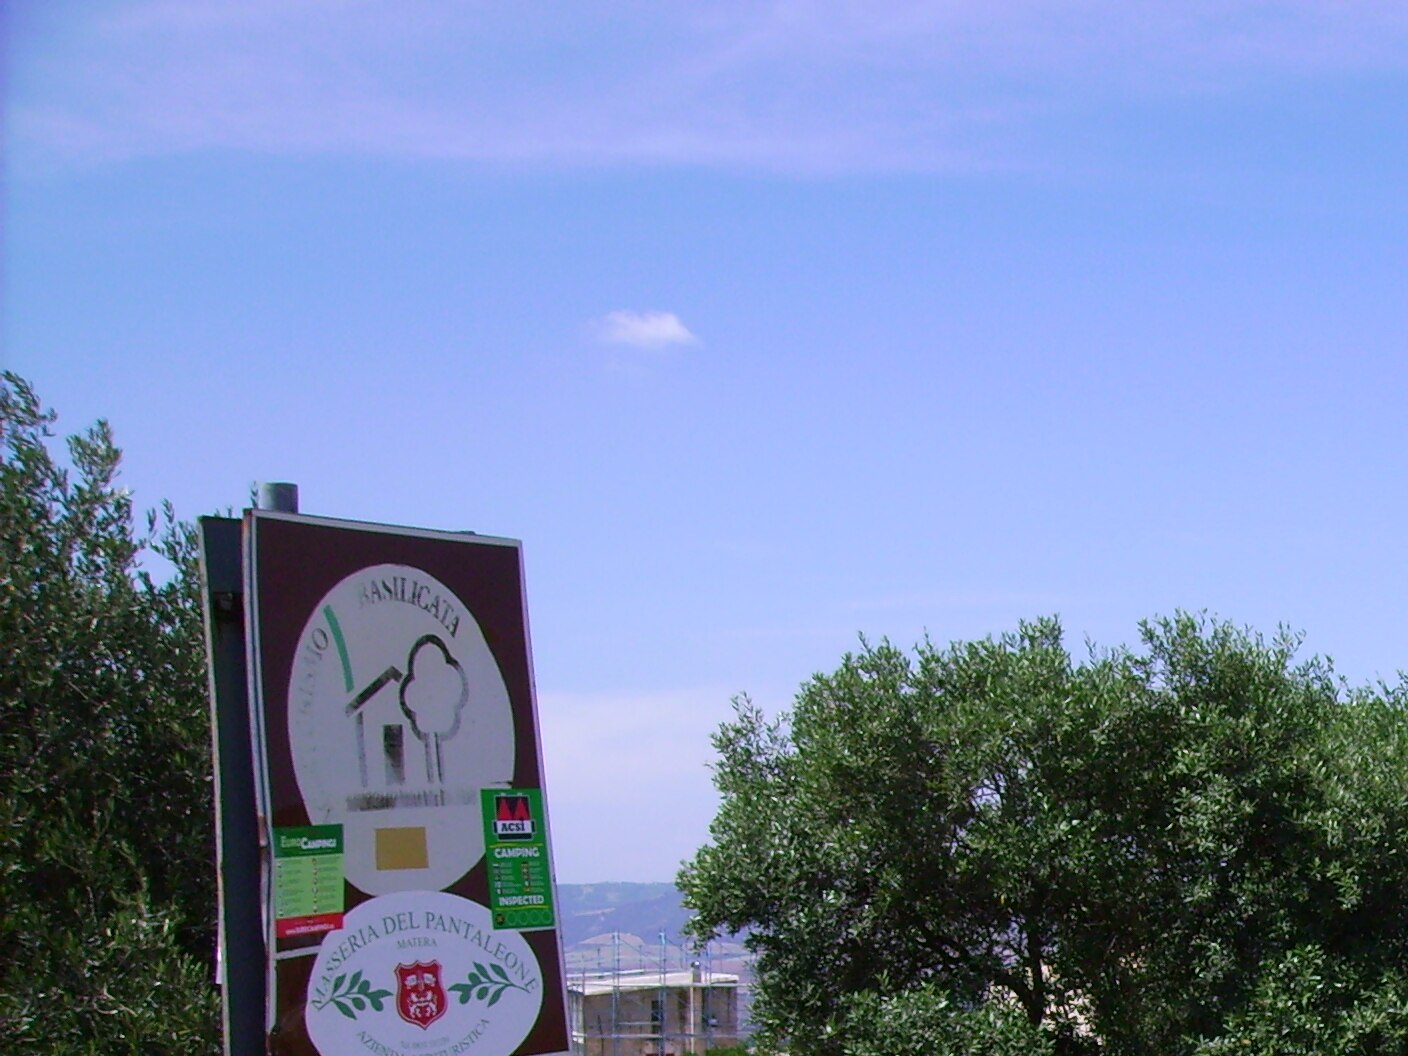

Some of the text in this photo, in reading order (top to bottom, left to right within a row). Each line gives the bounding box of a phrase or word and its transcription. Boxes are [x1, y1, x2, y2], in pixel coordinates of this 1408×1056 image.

[494, 847, 540, 858] CAMPING
[498, 894, 545, 906] INSPECTED
[397, 936, 437, 949] MATERA
[311, 911, 540, 1012] MASSERIA DEL PANTALEONE
